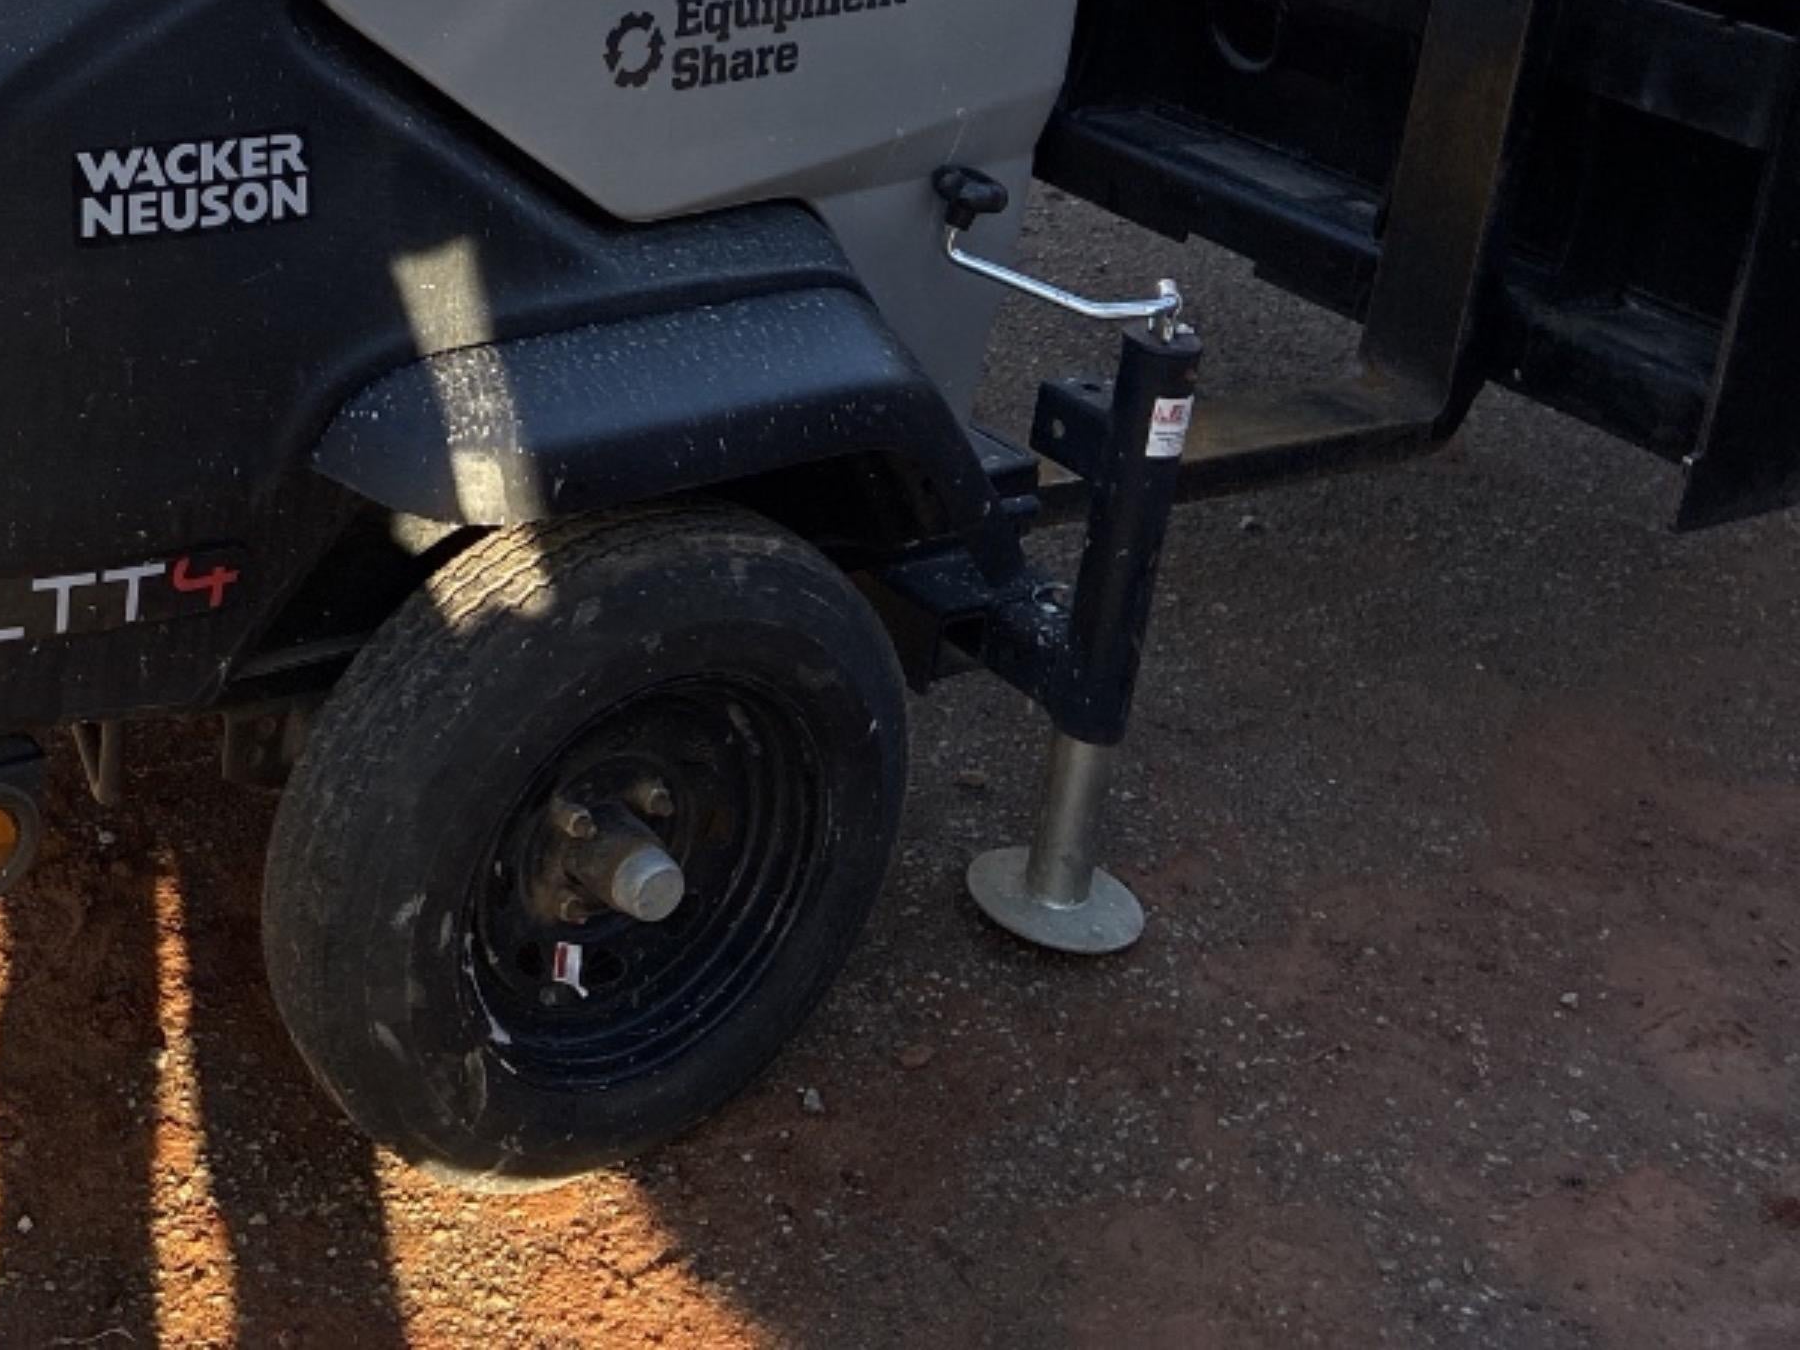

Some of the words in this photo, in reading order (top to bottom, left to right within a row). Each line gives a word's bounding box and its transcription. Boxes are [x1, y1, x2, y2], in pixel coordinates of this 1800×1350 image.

[671, 41, 799, 91] Share
[76, 133, 309, 194] WACKER
[80, 176, 309, 238] NEUSON
